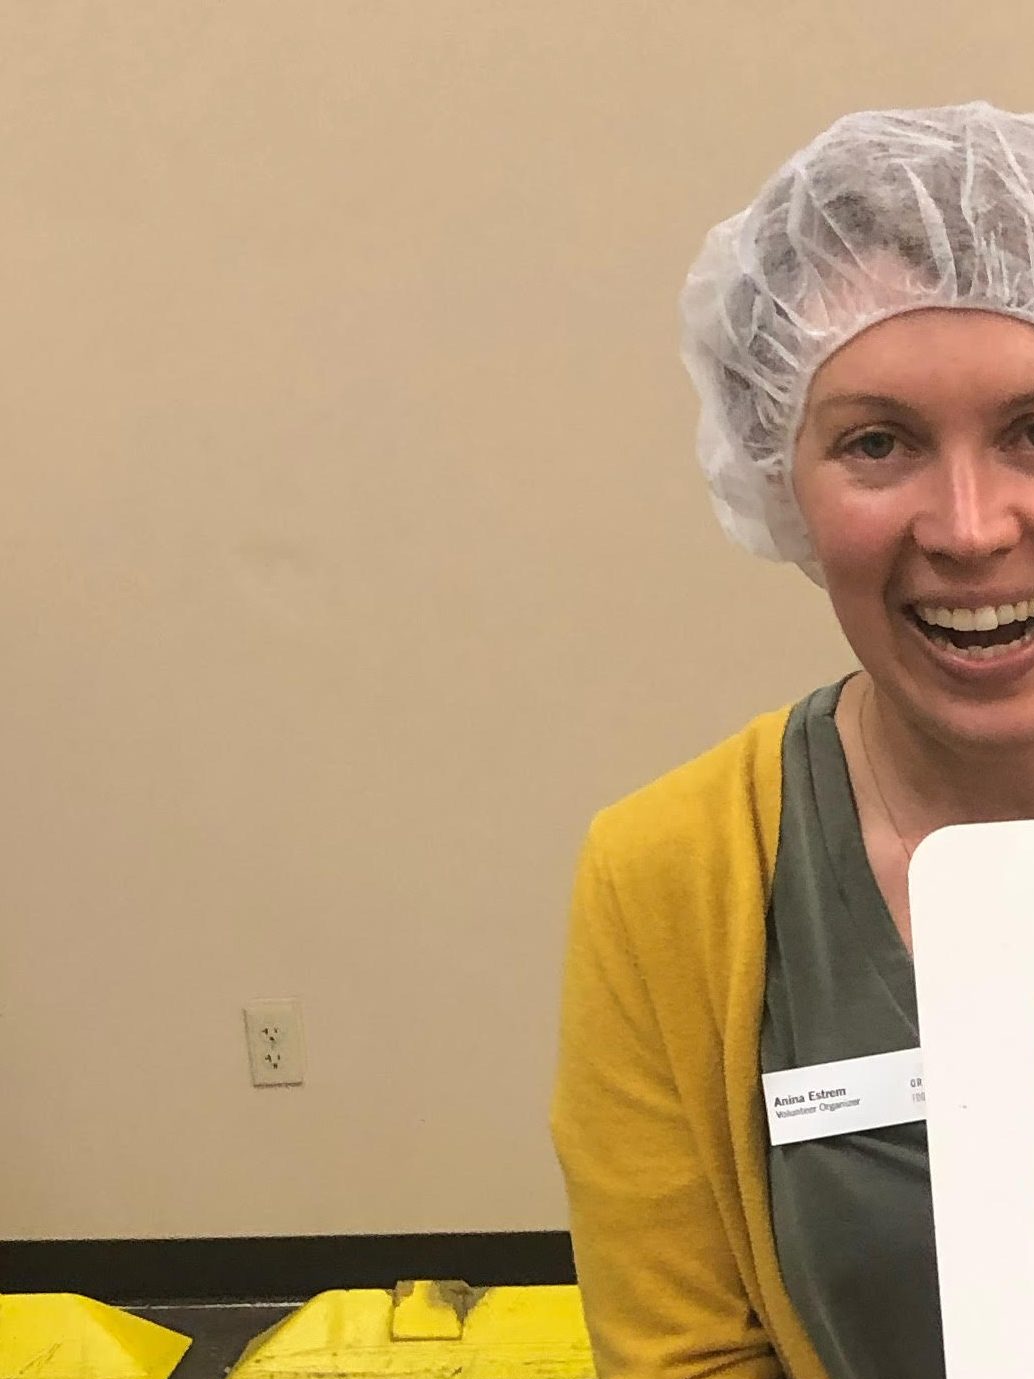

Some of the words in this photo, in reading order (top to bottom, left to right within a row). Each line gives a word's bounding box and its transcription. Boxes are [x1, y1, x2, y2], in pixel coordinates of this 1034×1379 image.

[774, 1094, 806, 1108] Anina
[808, 1087, 847, 1101] Estrem
[776, 1105, 817, 1119] Volunteer
[819, 1098, 861, 1112] Organizer
